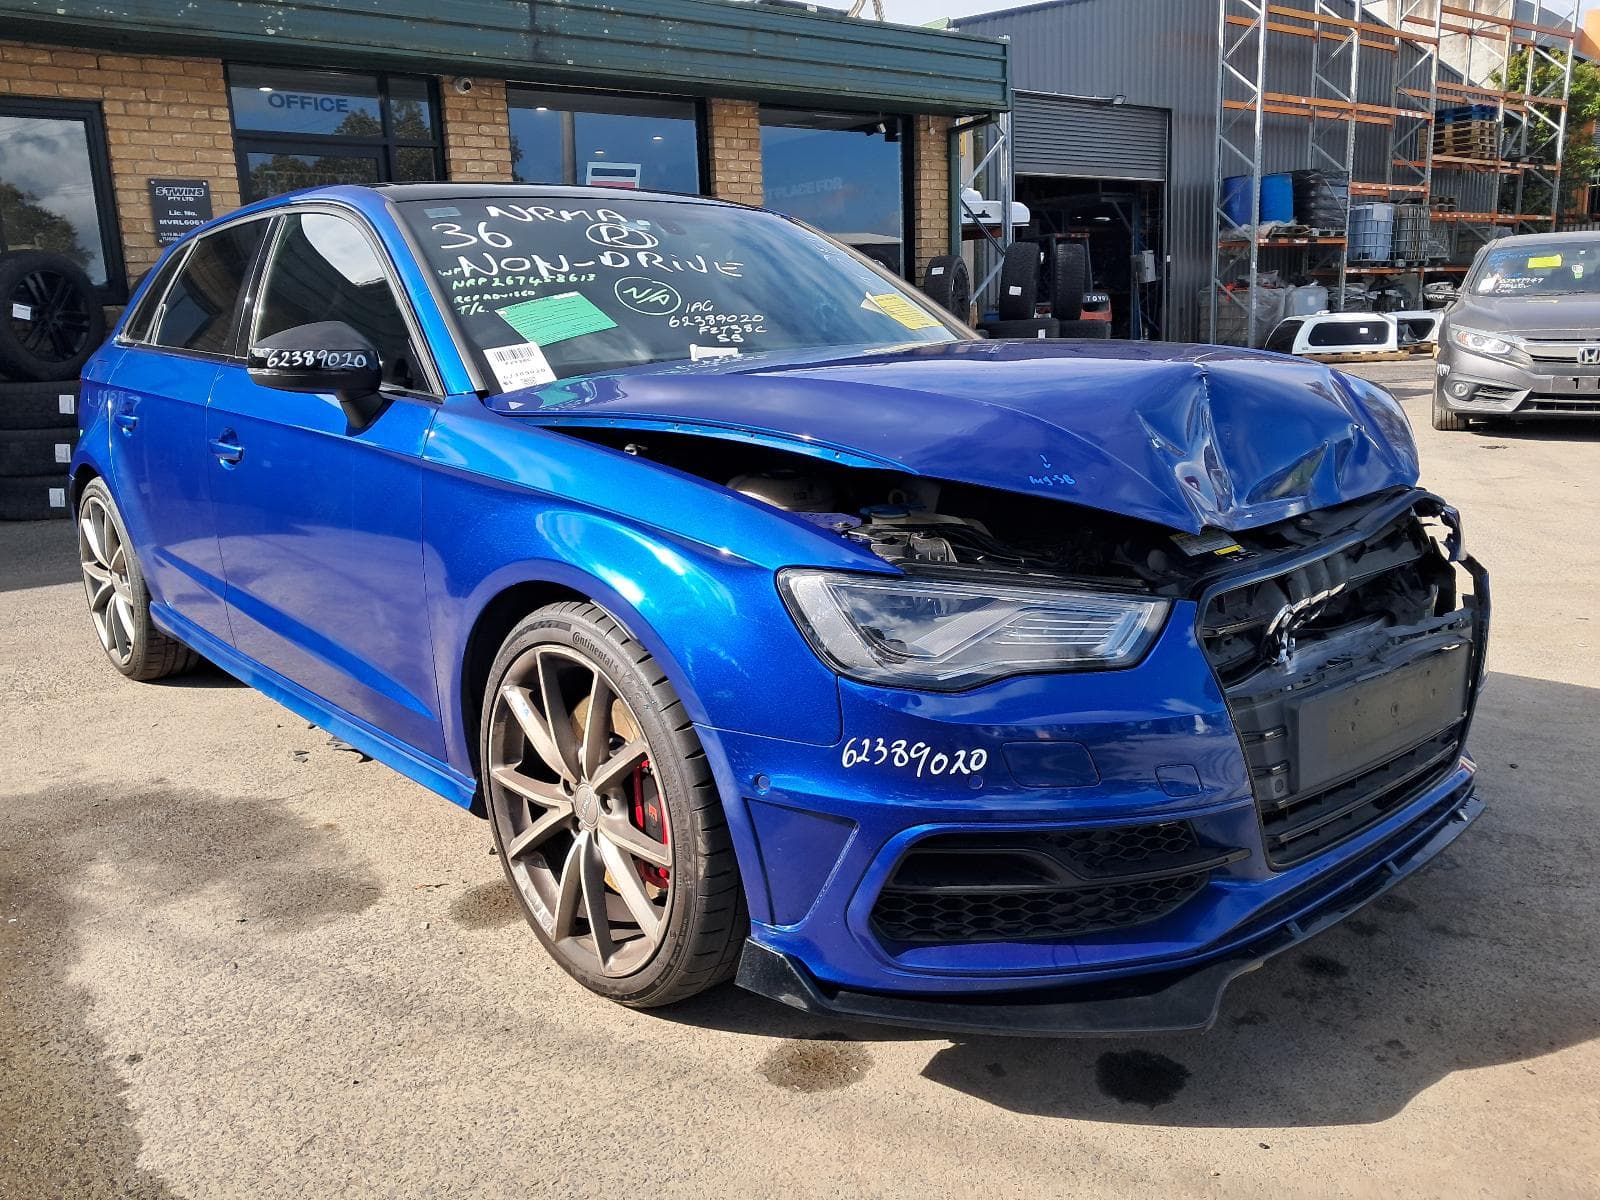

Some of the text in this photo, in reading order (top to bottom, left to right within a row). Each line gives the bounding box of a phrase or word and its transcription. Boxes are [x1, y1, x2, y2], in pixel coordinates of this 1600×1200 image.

[268, 93, 349, 112] OFFICE
[486, 204, 628, 222] NRMA
[431, 222, 513, 249] 36
[668, 314, 764, 328] 62389020
[266, 349, 367, 369] 62389020
[572, 631, 613, 668] Continental
[841, 737, 988, 778] 62389020
